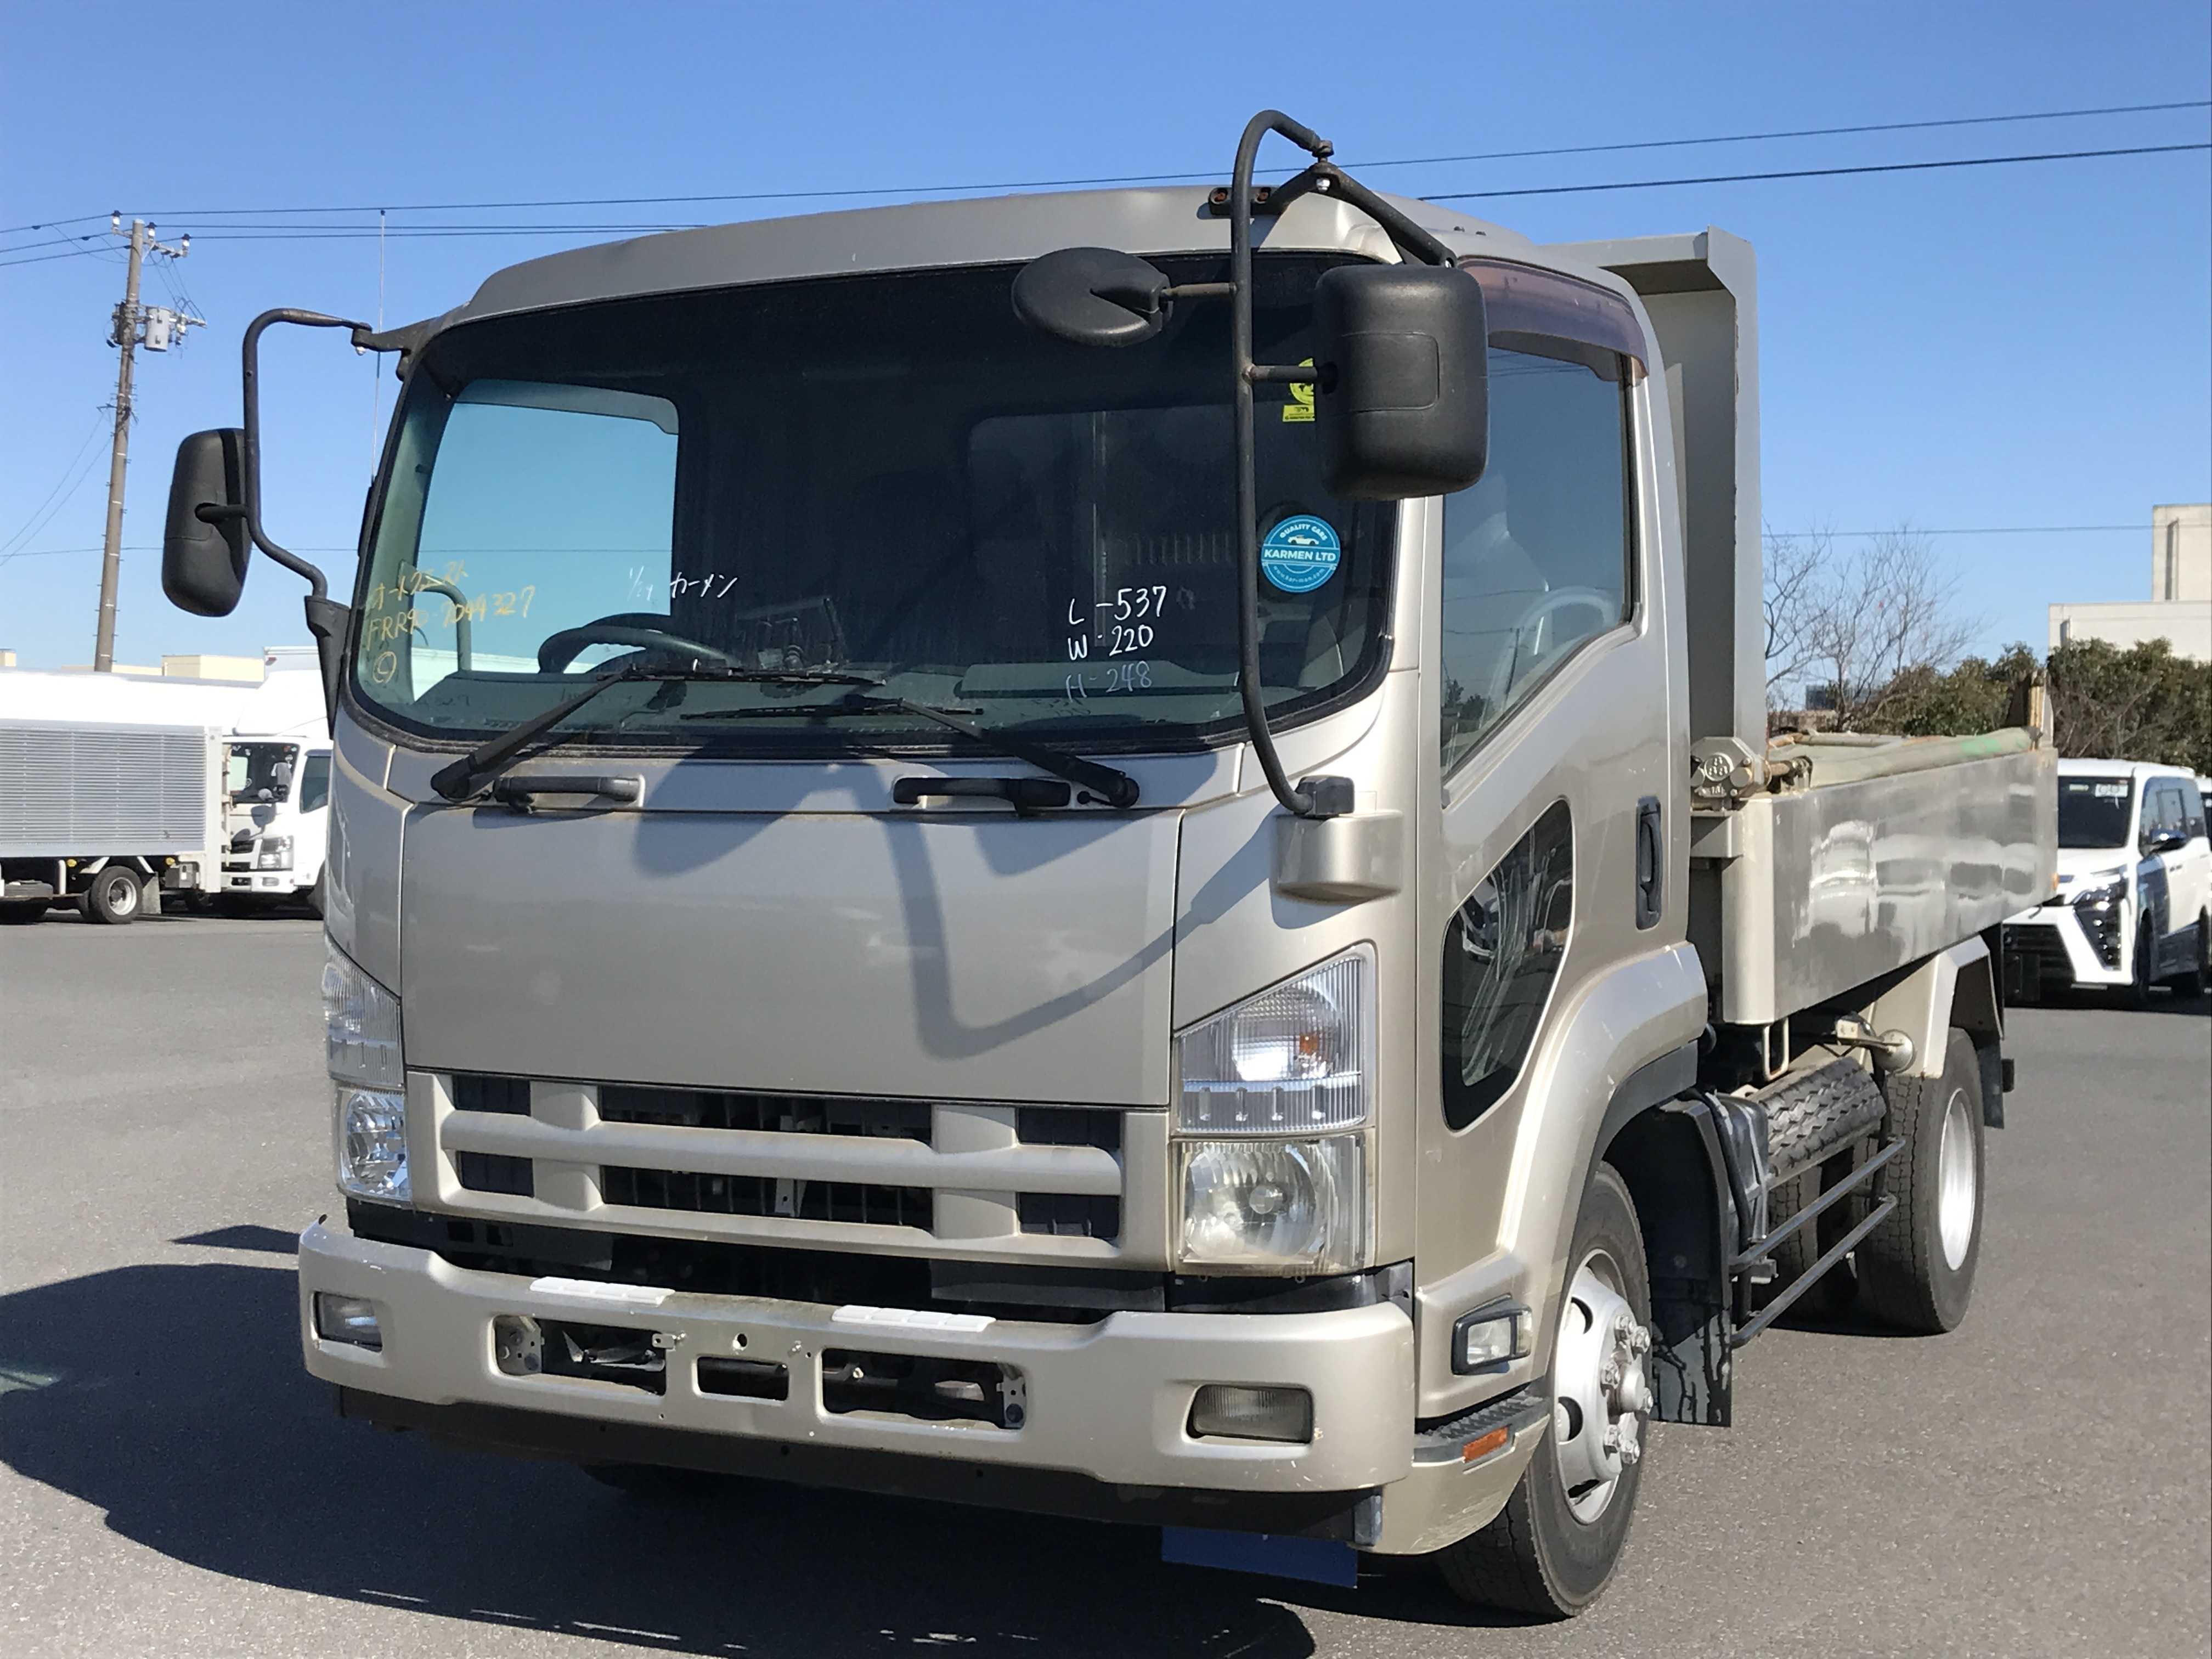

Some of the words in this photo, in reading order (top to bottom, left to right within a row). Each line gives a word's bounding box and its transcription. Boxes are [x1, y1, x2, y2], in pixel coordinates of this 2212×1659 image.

[1279, 523, 1311, 538] QUALITY
[1311, 525, 1328, 541] CARS
[1264, 549, 1313, 560] KARMEN
[1315, 551, 1336, 561] LTD
